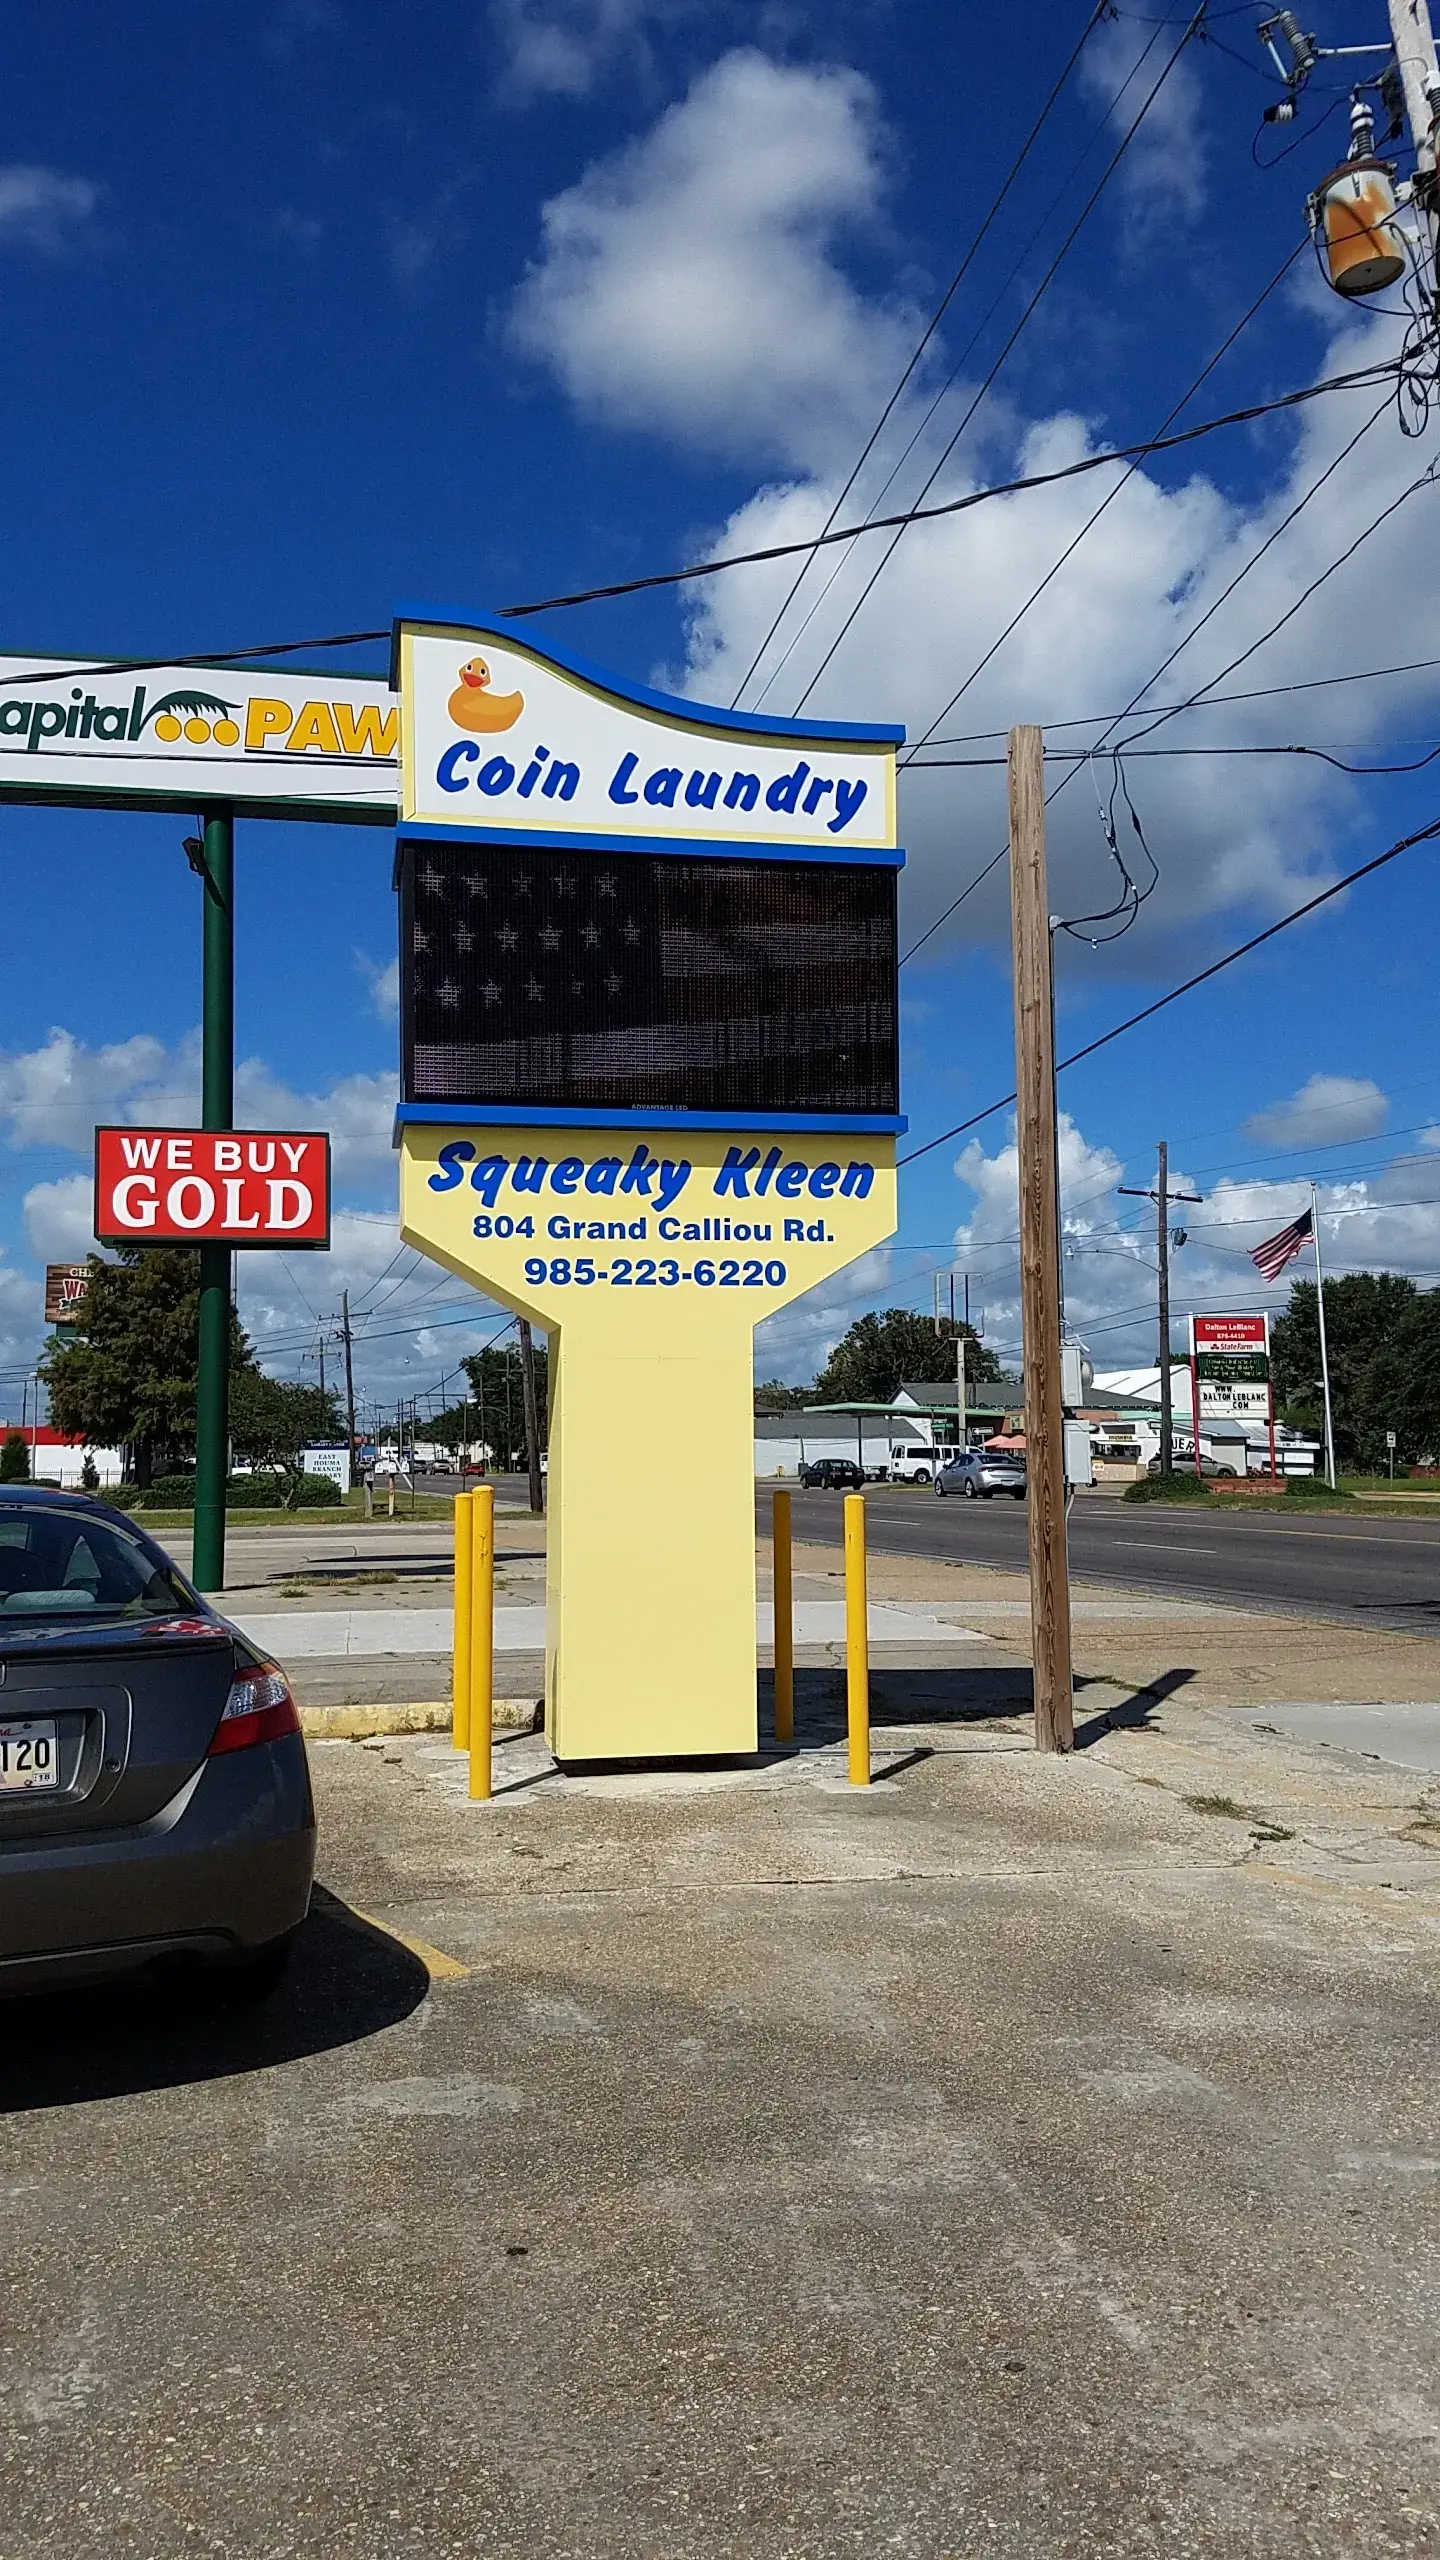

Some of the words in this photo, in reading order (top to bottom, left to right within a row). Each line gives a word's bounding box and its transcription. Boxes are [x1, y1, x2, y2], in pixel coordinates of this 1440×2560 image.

[435, 740, 580, 801] Coin
[608, 752, 868, 833] Laundry
[631, 1103, 674, 1111] ADVANTAGE
[120, 1138, 194, 1170] WE
[214, 1141, 309, 1173] BUY
[427, 1140, 692, 1212] Squeaky
[713, 1145, 875, 1199] Kleen
[112, 1175, 313, 1229] GOLD
[472, 1215, 535, 1239] 804
[547, 1215, 647, 1241] Grand
[658, 1217, 772, 1242] Calliou
[783, 1218, 835, 1242] Rd.
[523, 1257, 788, 1287] 985-223-6220
[1204, 1323, 1228, 1331] Dalton
[1228, 1323, 1256, 1331] LeBlanc
[1, 1738, 50, 1772] 120
